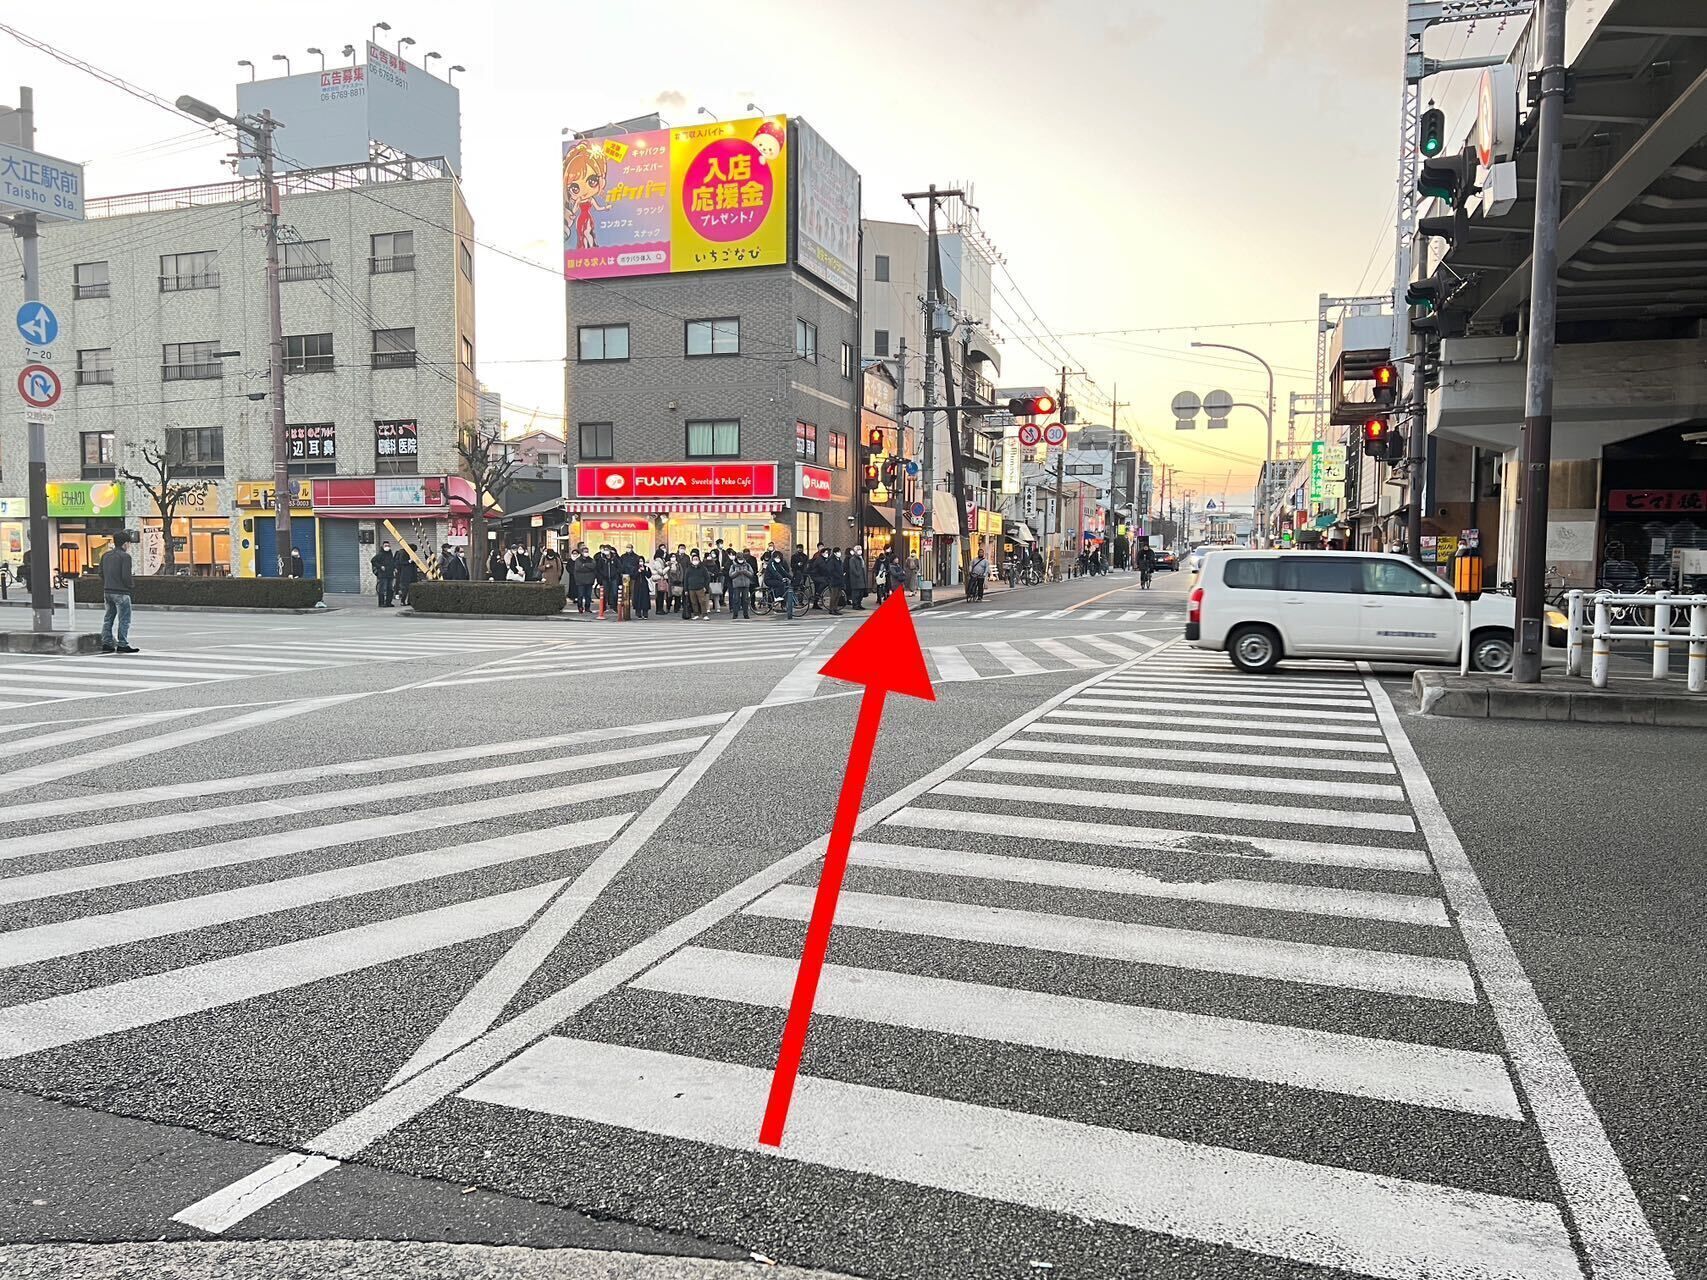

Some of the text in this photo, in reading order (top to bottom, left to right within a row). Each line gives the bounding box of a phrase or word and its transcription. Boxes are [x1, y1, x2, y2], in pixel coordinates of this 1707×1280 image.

[370, 46, 407, 74] 広告募集
[321, 67, 364, 86] 広告募集
[1, 155, 78, 195] 大正駅前
[623, 163, 663, 174] ガールズバー
[703, 154, 751, 183] 入店
[4, 181, 78, 211] Taisho Sta.
[691, 181, 764, 212] 応援金
[636, 204, 664, 215] ラウンジ
[600, 219, 633, 229] コンカフェ
[701, 211, 754, 227] プレゼント!
[634, 228, 660, 238] スナック
[695, 245, 761, 263] いちごなび
[1049, 428, 1062, 439] 30
[285, 440, 334, 456] 辺耳鼻
[635, 476, 687, 486] FUJIYA
[691, 477, 713, 485] Sweets
[721, 477, 736, 485] Peko
[736, 477, 752, 487] Cafe
[811, 478, 830, 490] FUJIYA
[150, 533, 159, 568] パン屋さん
